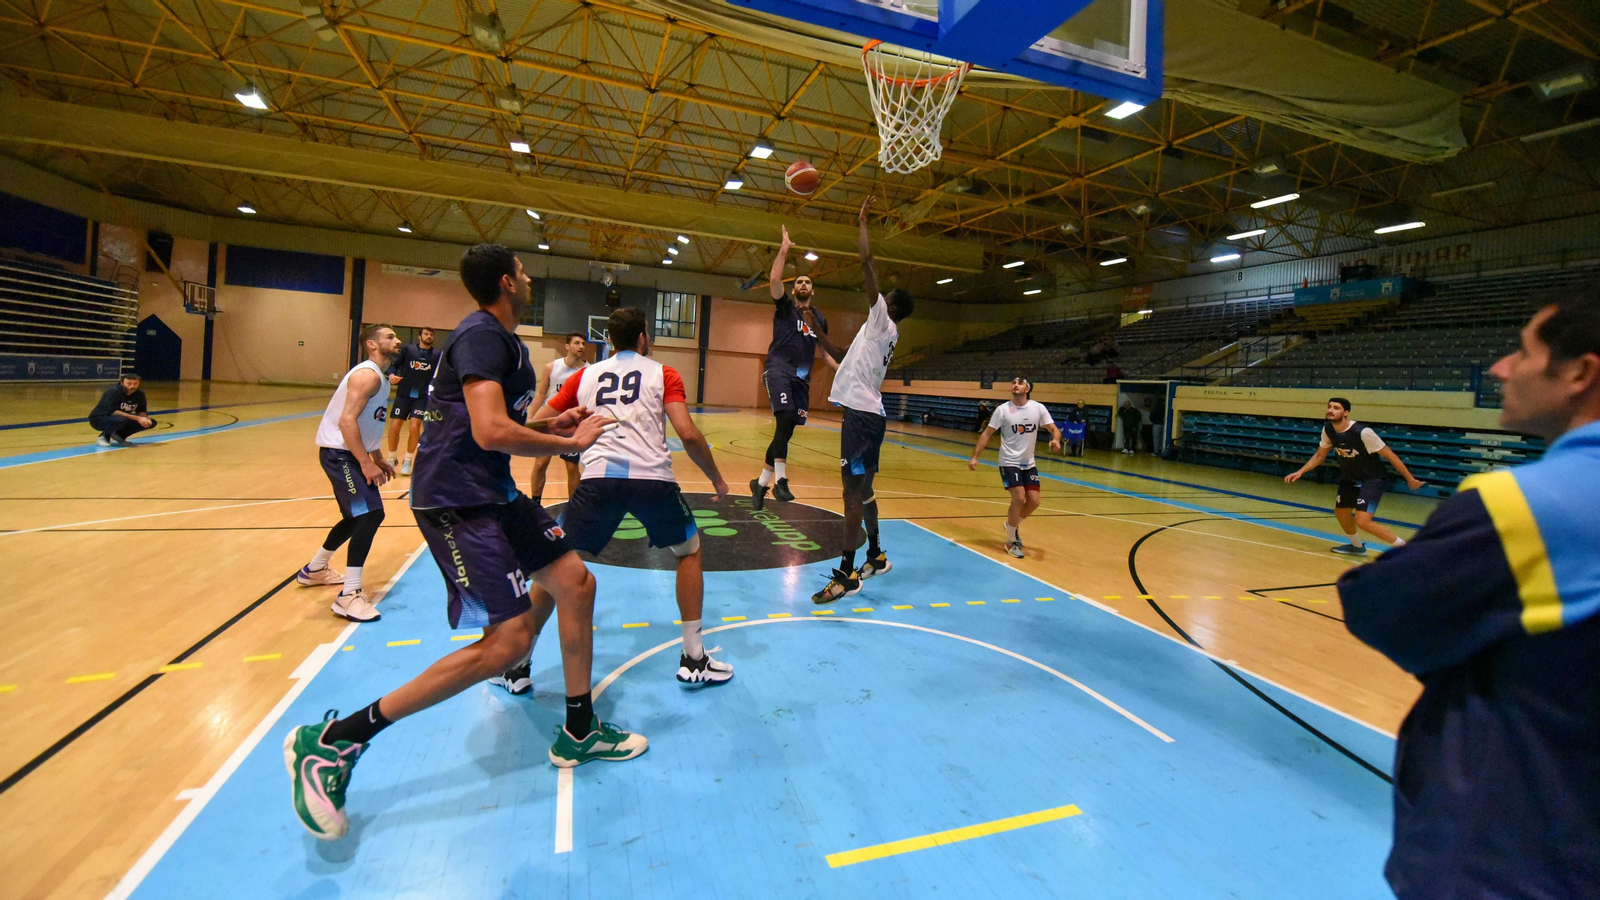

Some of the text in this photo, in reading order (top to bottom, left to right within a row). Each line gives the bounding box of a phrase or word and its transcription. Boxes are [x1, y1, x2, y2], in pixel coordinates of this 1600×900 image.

[1379, 244, 1472, 271] FUMAR
[596, 370, 642, 406] 29
[779, 392, 788, 404] 2
[1011, 423, 1037, 435] UDEA
[506, 568, 528, 599] 12
